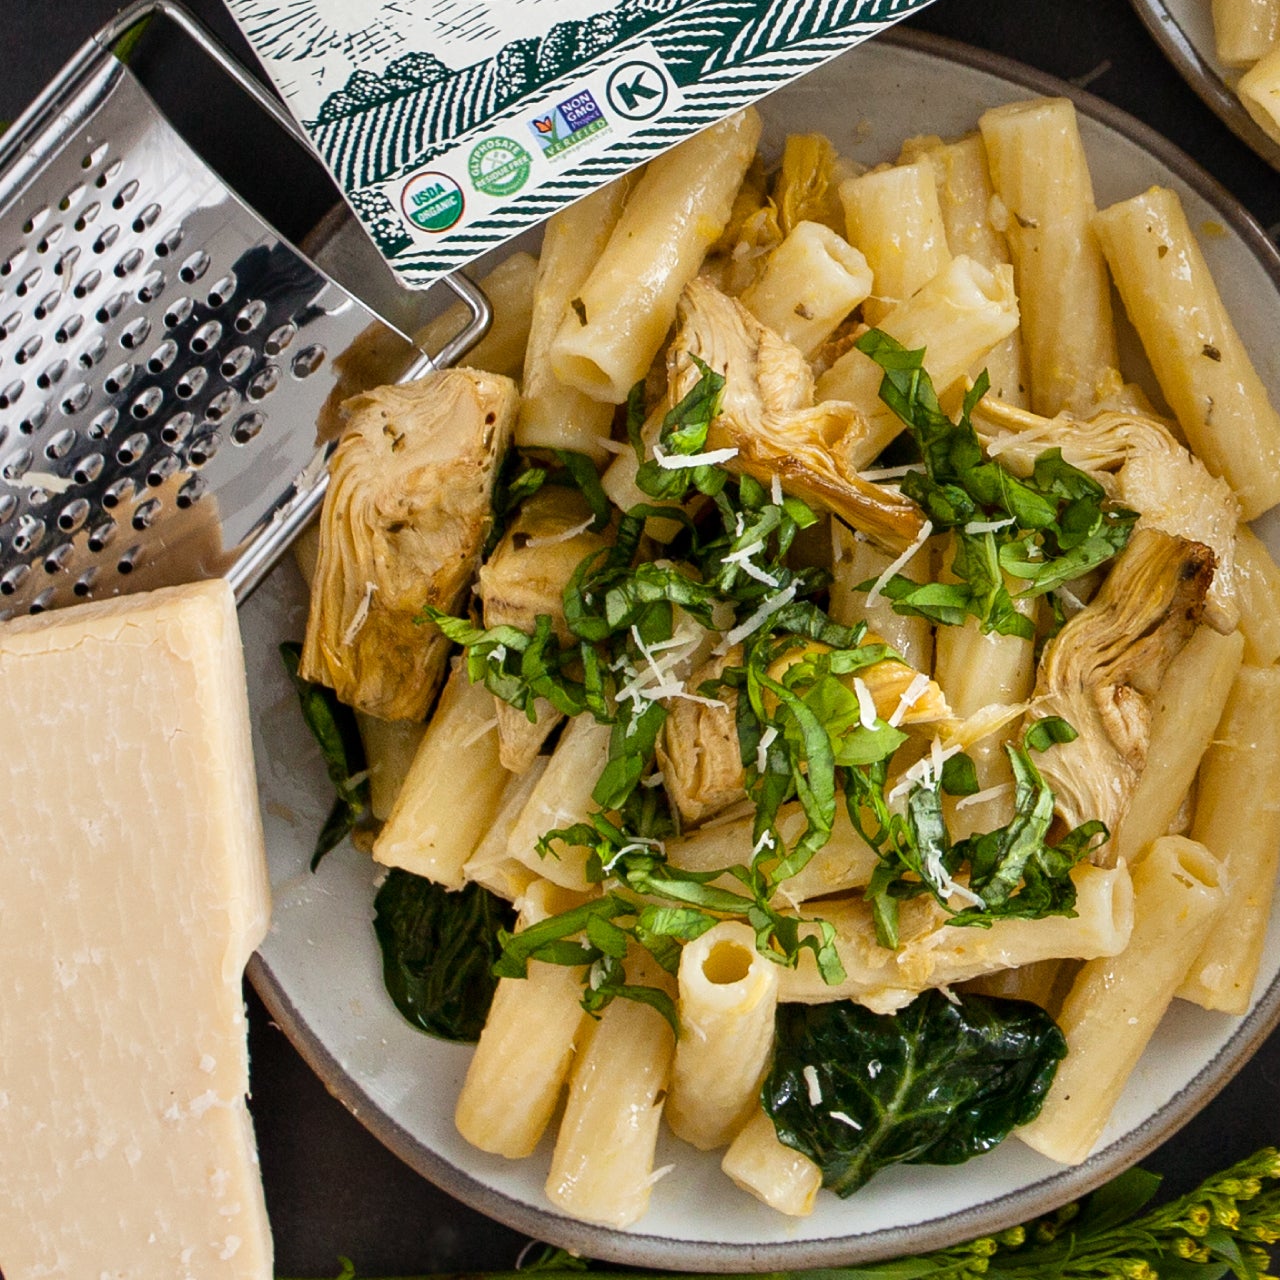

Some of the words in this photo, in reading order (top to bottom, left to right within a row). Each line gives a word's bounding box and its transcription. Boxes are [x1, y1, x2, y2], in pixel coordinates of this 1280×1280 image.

[561, 93, 591, 113] NON
[616, 71, 662, 111] K
[567, 101, 596, 122] GMO
[546, 118, 607, 155] VERIFIED
[470, 138, 521, 177] GLYPHOSATE
[411, 182, 447, 208] USDA
[417, 195, 458, 224] ORGANIC
